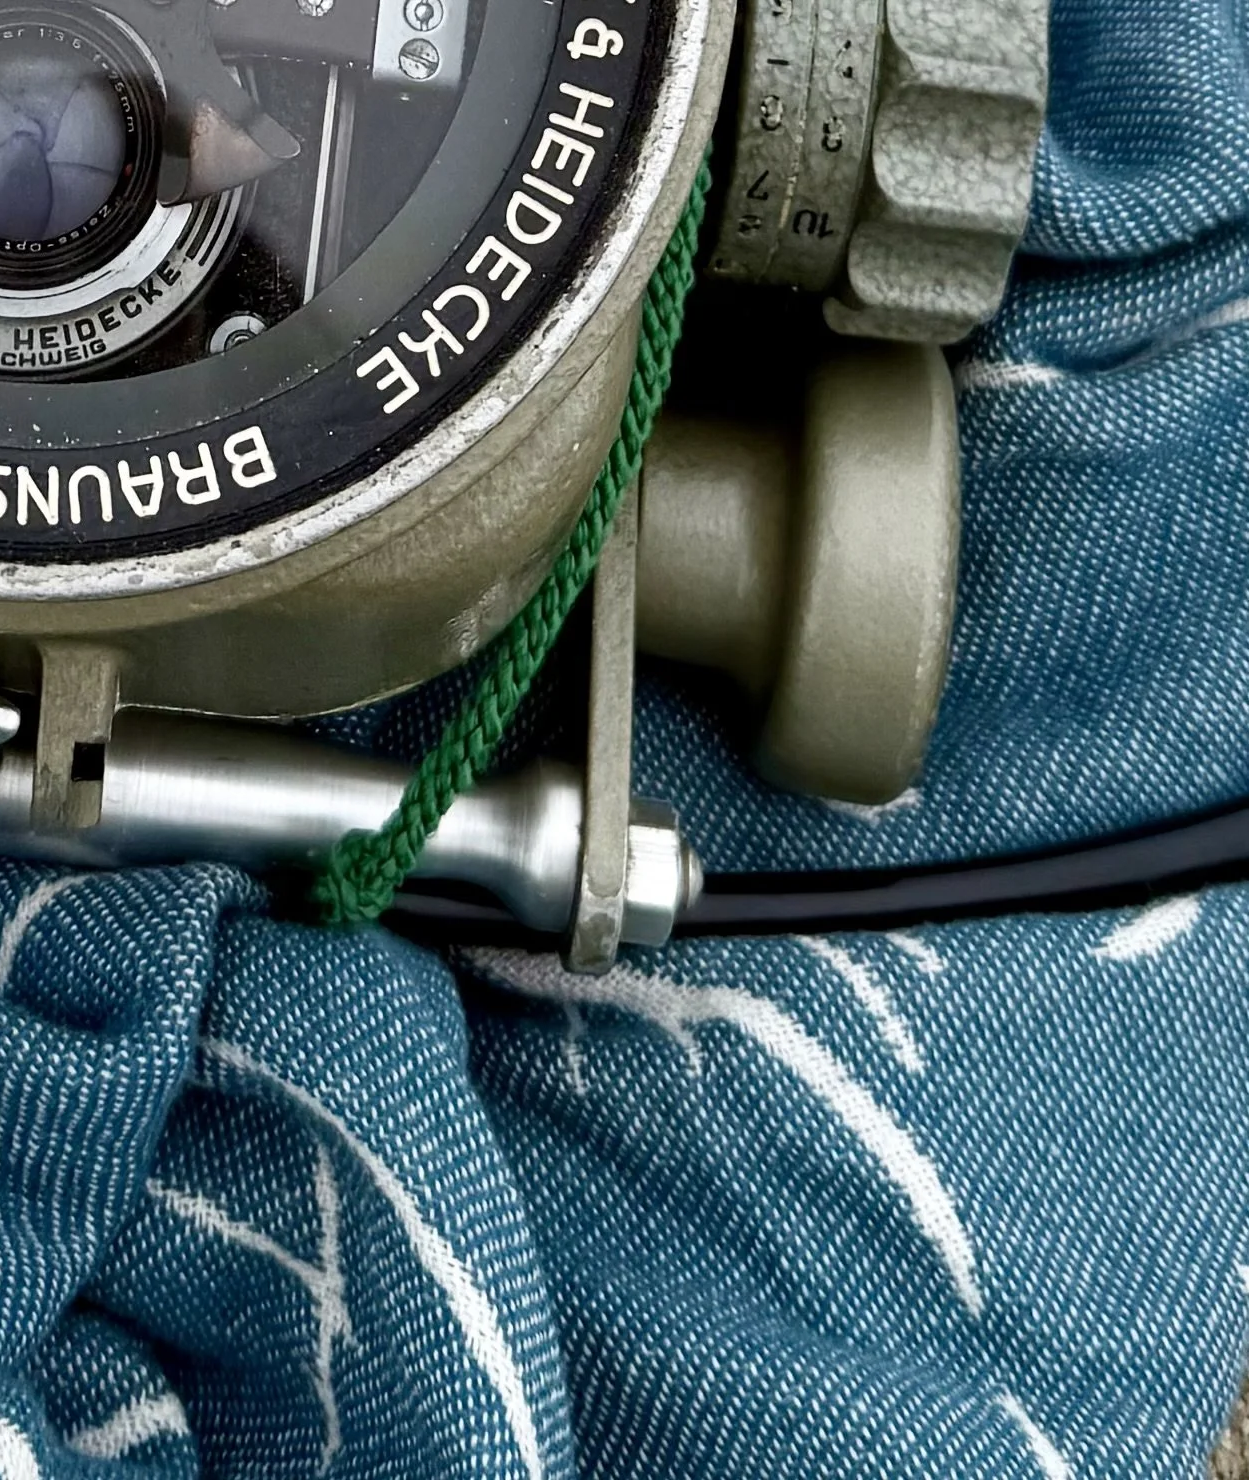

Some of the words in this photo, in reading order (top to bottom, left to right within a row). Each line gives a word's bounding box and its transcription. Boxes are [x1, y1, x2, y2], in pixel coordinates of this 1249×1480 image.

[566, 16, 624, 61] &
[355, 81, 616, 415] HEIDECKE
[13, 260, 182, 352] HEIDECKE
